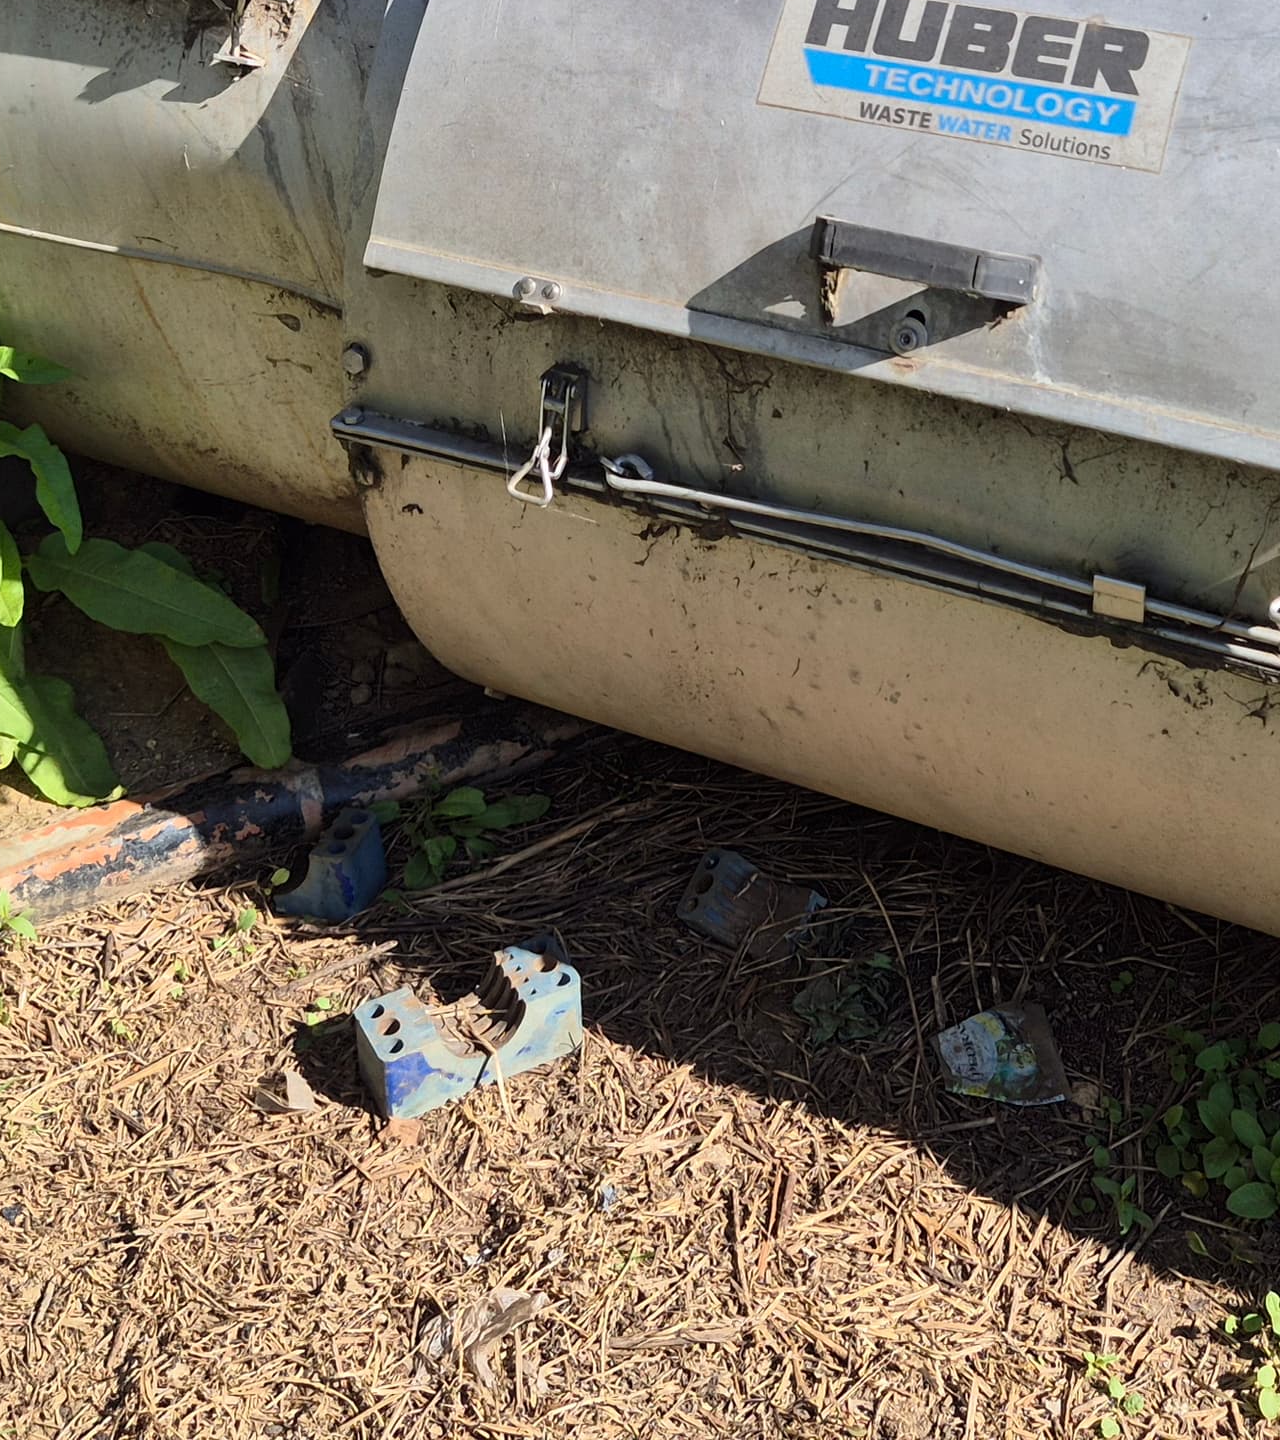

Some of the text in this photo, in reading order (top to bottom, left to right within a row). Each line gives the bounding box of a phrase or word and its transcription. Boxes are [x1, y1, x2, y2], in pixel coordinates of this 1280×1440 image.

[864, 64, 1120, 126] TECHNOLOGY
[859, 101, 1111, 160] WASTE WATER Solutions
